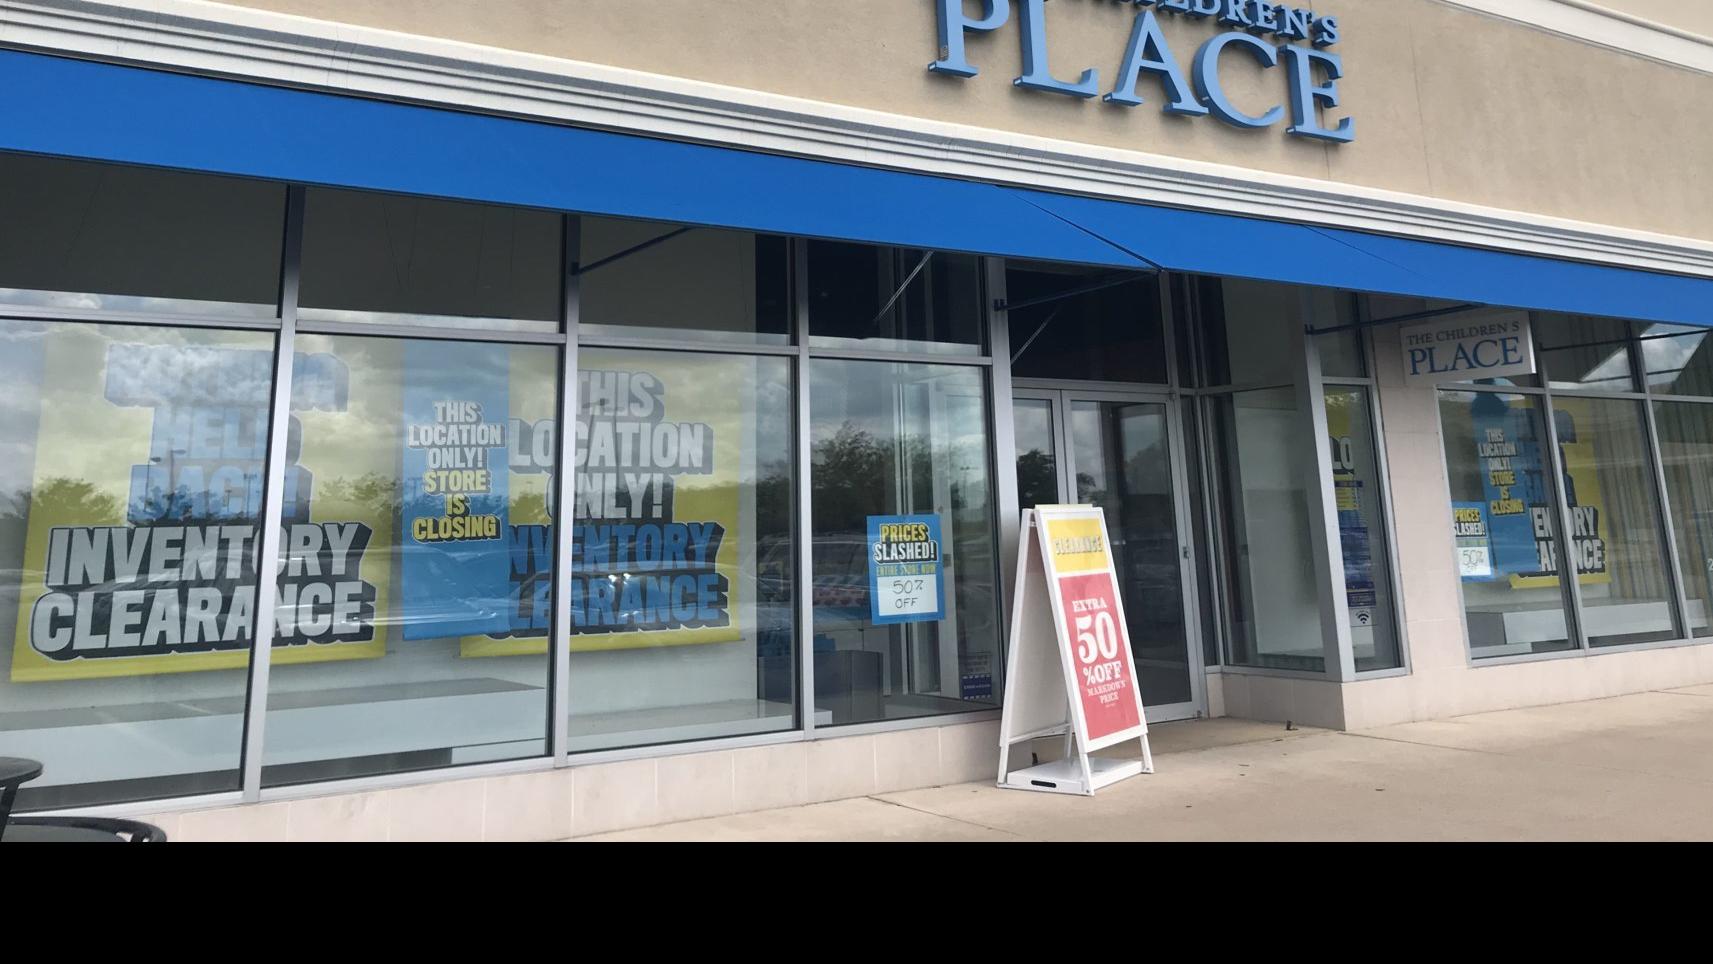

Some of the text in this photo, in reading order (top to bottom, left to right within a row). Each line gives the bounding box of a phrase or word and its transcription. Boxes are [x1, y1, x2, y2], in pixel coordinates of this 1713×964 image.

[1122, 0, 1340, 46] DREN'S
[928, 0, 1355, 143] PLACE
[1407, 320, 1521, 346] THE CHILDRENS
[1408, 336, 1524, 376] PLACE
[576, 369, 656, 418] THIS
[434, 400, 479, 423] THIS
[152, 406, 290, 460] HEL
[408, 424, 502, 446] LOCATION
[508, 419, 704, 468] LOCATION
[428, 446, 484, 469] ONLY!
[423, 470, 488, 492] STORE
[445, 493, 467, 515] IS
[548, 472, 664, 519] NLY!
[1456, 508, 1480, 521] PRICES
[412, 516, 498, 540] CLOSING
[881, 524, 927, 542] PRICES
[508, 522, 717, 576] NVENTORY
[874, 542, 936, 562] SLASHED!
[892, 579, 924, 595] 50%
[508, 573, 719, 630] LERANCE
[895, 597, 919, 609] OFF
[1072, 597, 1107, 613] EXTRA
[32, 580, 364, 652] CLEARANCE
[1075, 611, 1119, 664] 50
[1083, 661, 1122, 687] %OFF
